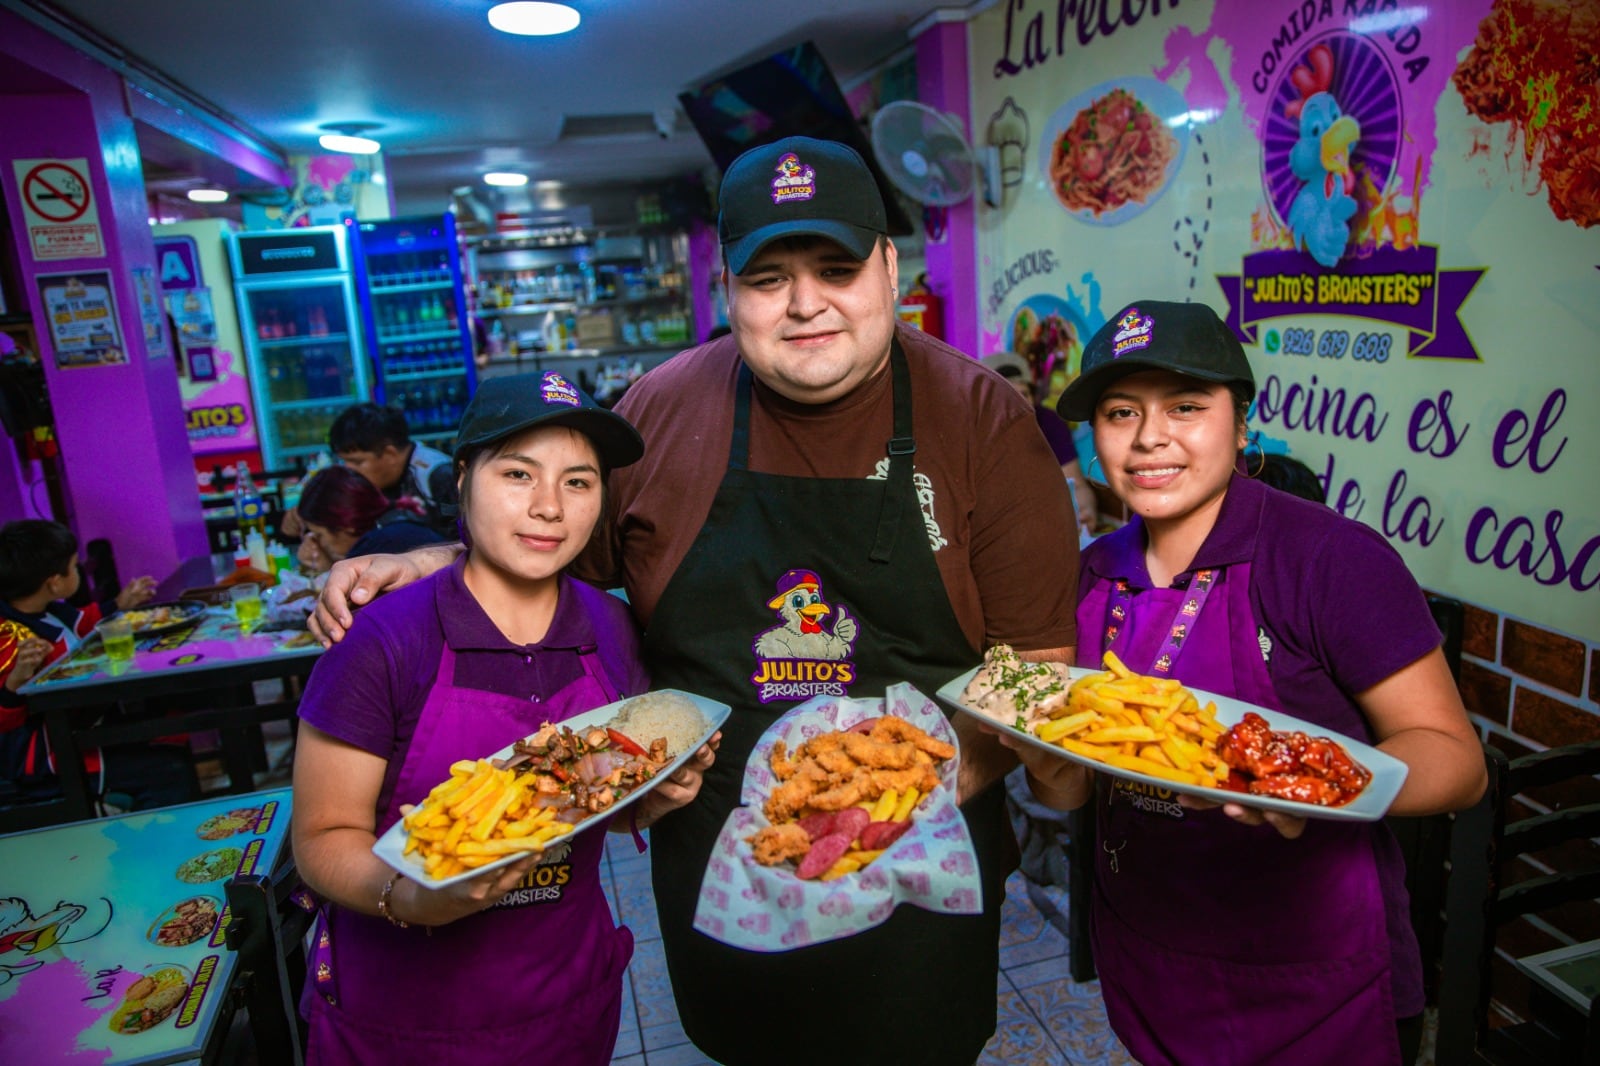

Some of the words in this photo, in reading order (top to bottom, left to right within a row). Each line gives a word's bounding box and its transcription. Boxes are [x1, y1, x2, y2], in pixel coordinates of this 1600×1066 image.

[1252, 0, 1333, 94] COMIDA
[1282, 327, 1314, 355] 926
[1317, 330, 1349, 358] 619
[1352, 332, 1392, 362] 608
[1257, 374, 1389, 443] ocina
[1407, 390, 1470, 458] es
[1492, 388, 1568, 474] el
[1381, 469, 1445, 547] la
[1464, 506, 1600, 592] casa
[754, 661, 852, 682] JULITO'S
[761, 682, 843, 700] BROASTERS
